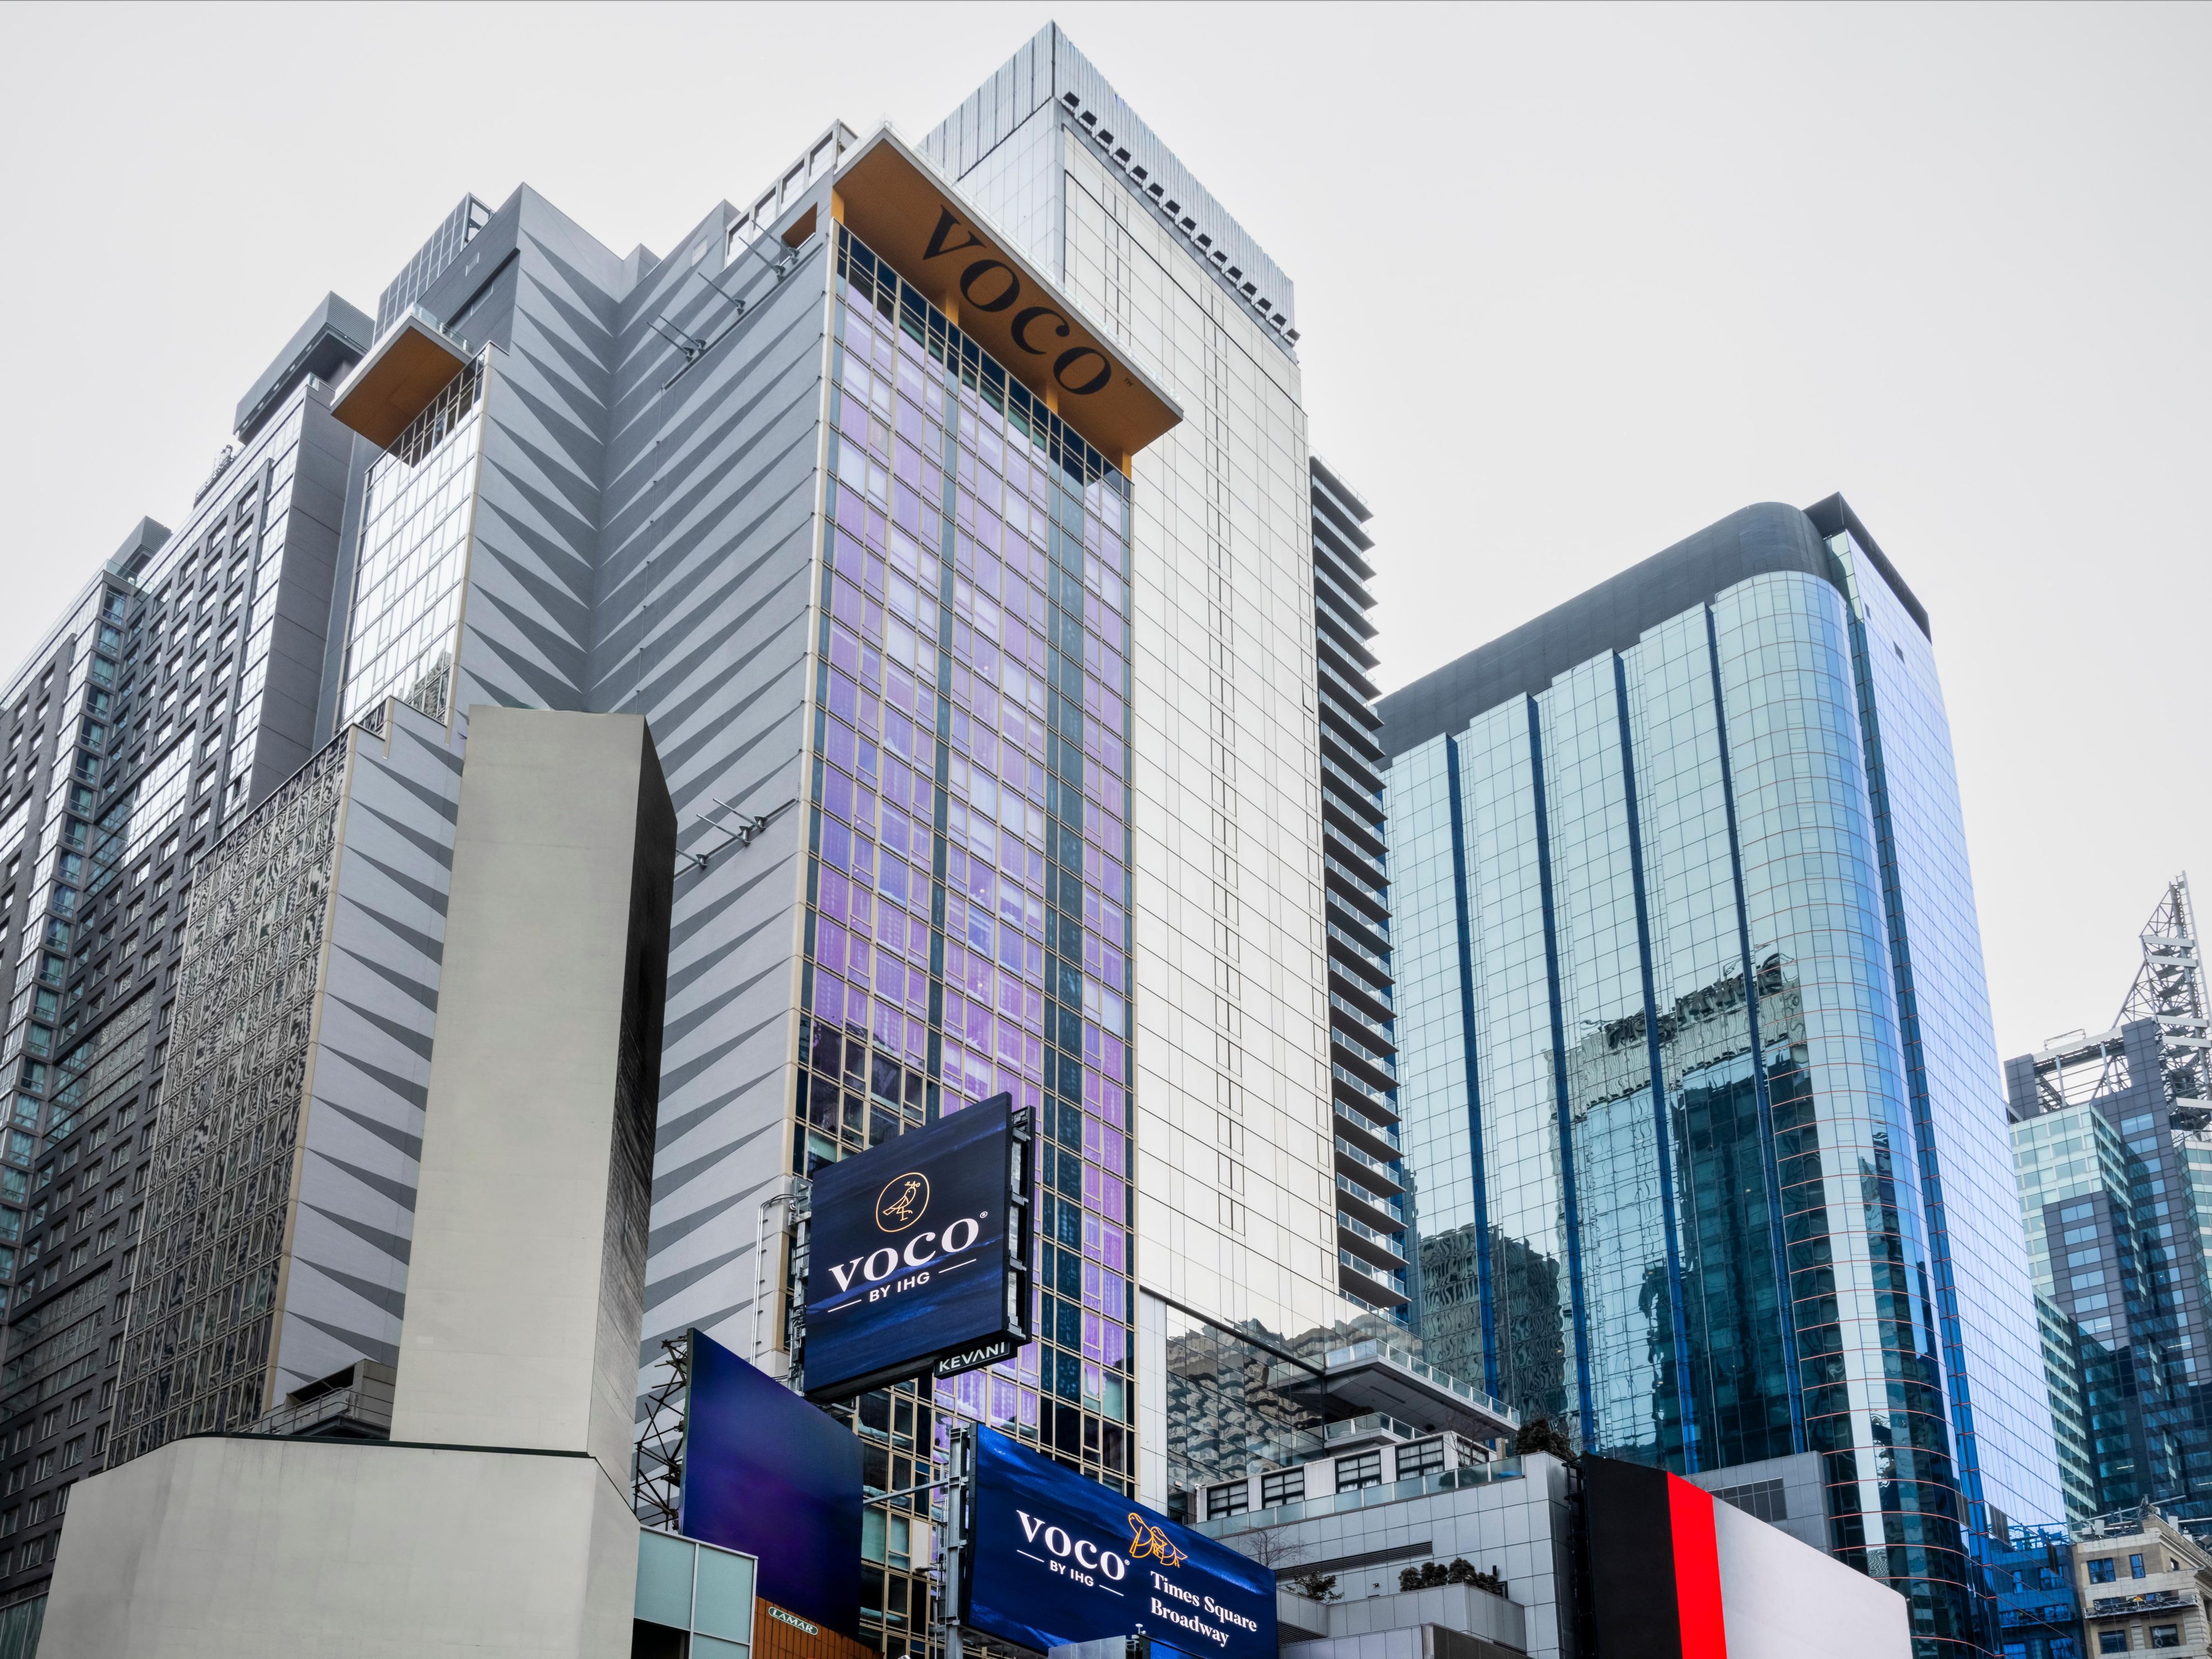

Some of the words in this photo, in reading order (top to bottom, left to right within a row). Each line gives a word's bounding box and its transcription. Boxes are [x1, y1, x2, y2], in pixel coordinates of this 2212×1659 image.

[869, 1284, 889, 1302] BY
[897, 1272, 930, 1293] IHG
[939, 1342, 1005, 1372] KEVANI
[1050, 1559, 1066, 1575] BY
[1071, 1569, 1094, 1587] IHG
[1150, 1571, 1200, 1607] Times
[1204, 1596, 1257, 1632] Square
[773, 1609, 813, 1633] LAMAR
[1151, 1597, 1230, 1647] Broadway
